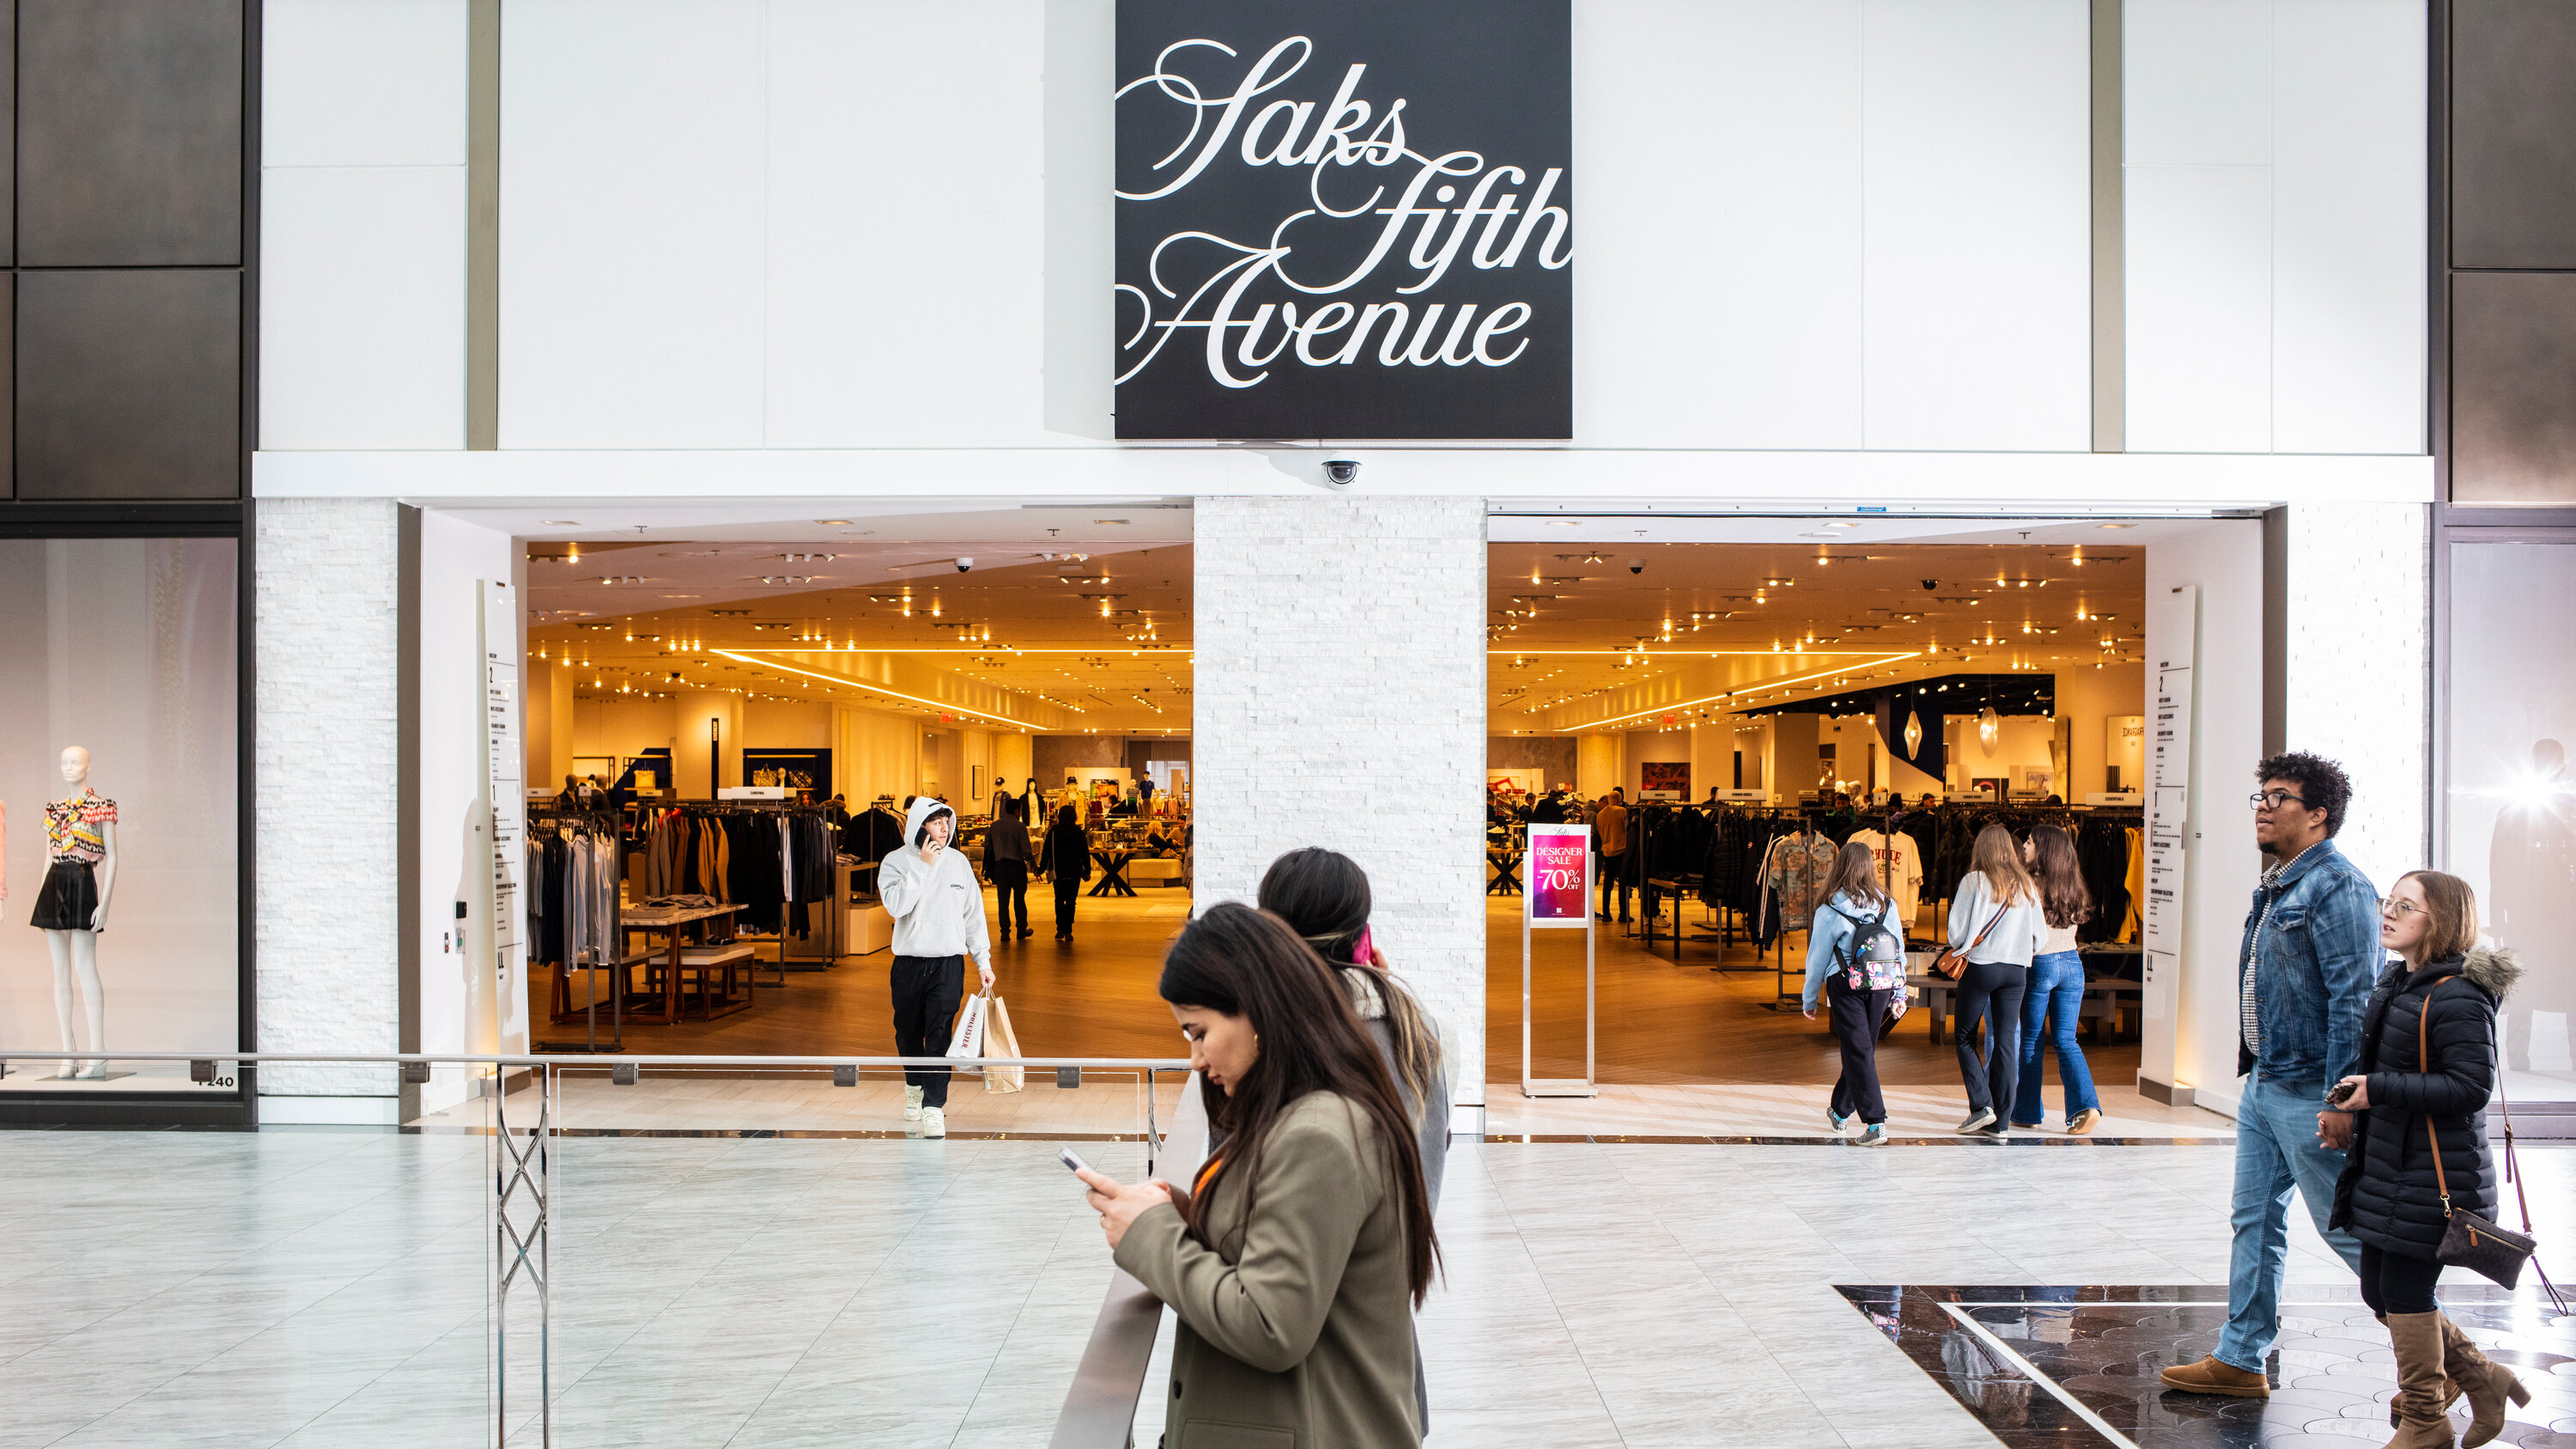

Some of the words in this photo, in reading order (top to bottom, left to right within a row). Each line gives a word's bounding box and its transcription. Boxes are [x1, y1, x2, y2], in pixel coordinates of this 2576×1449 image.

[1115, 36, 1406, 200] Saks
[1115, 231, 1532, 388] Avenue
[1536, 847, 1583, 856] DESIGNER
[1547, 855, 1571, 865] SALE
[962, 1012, 976, 1049] HOLLISTER
